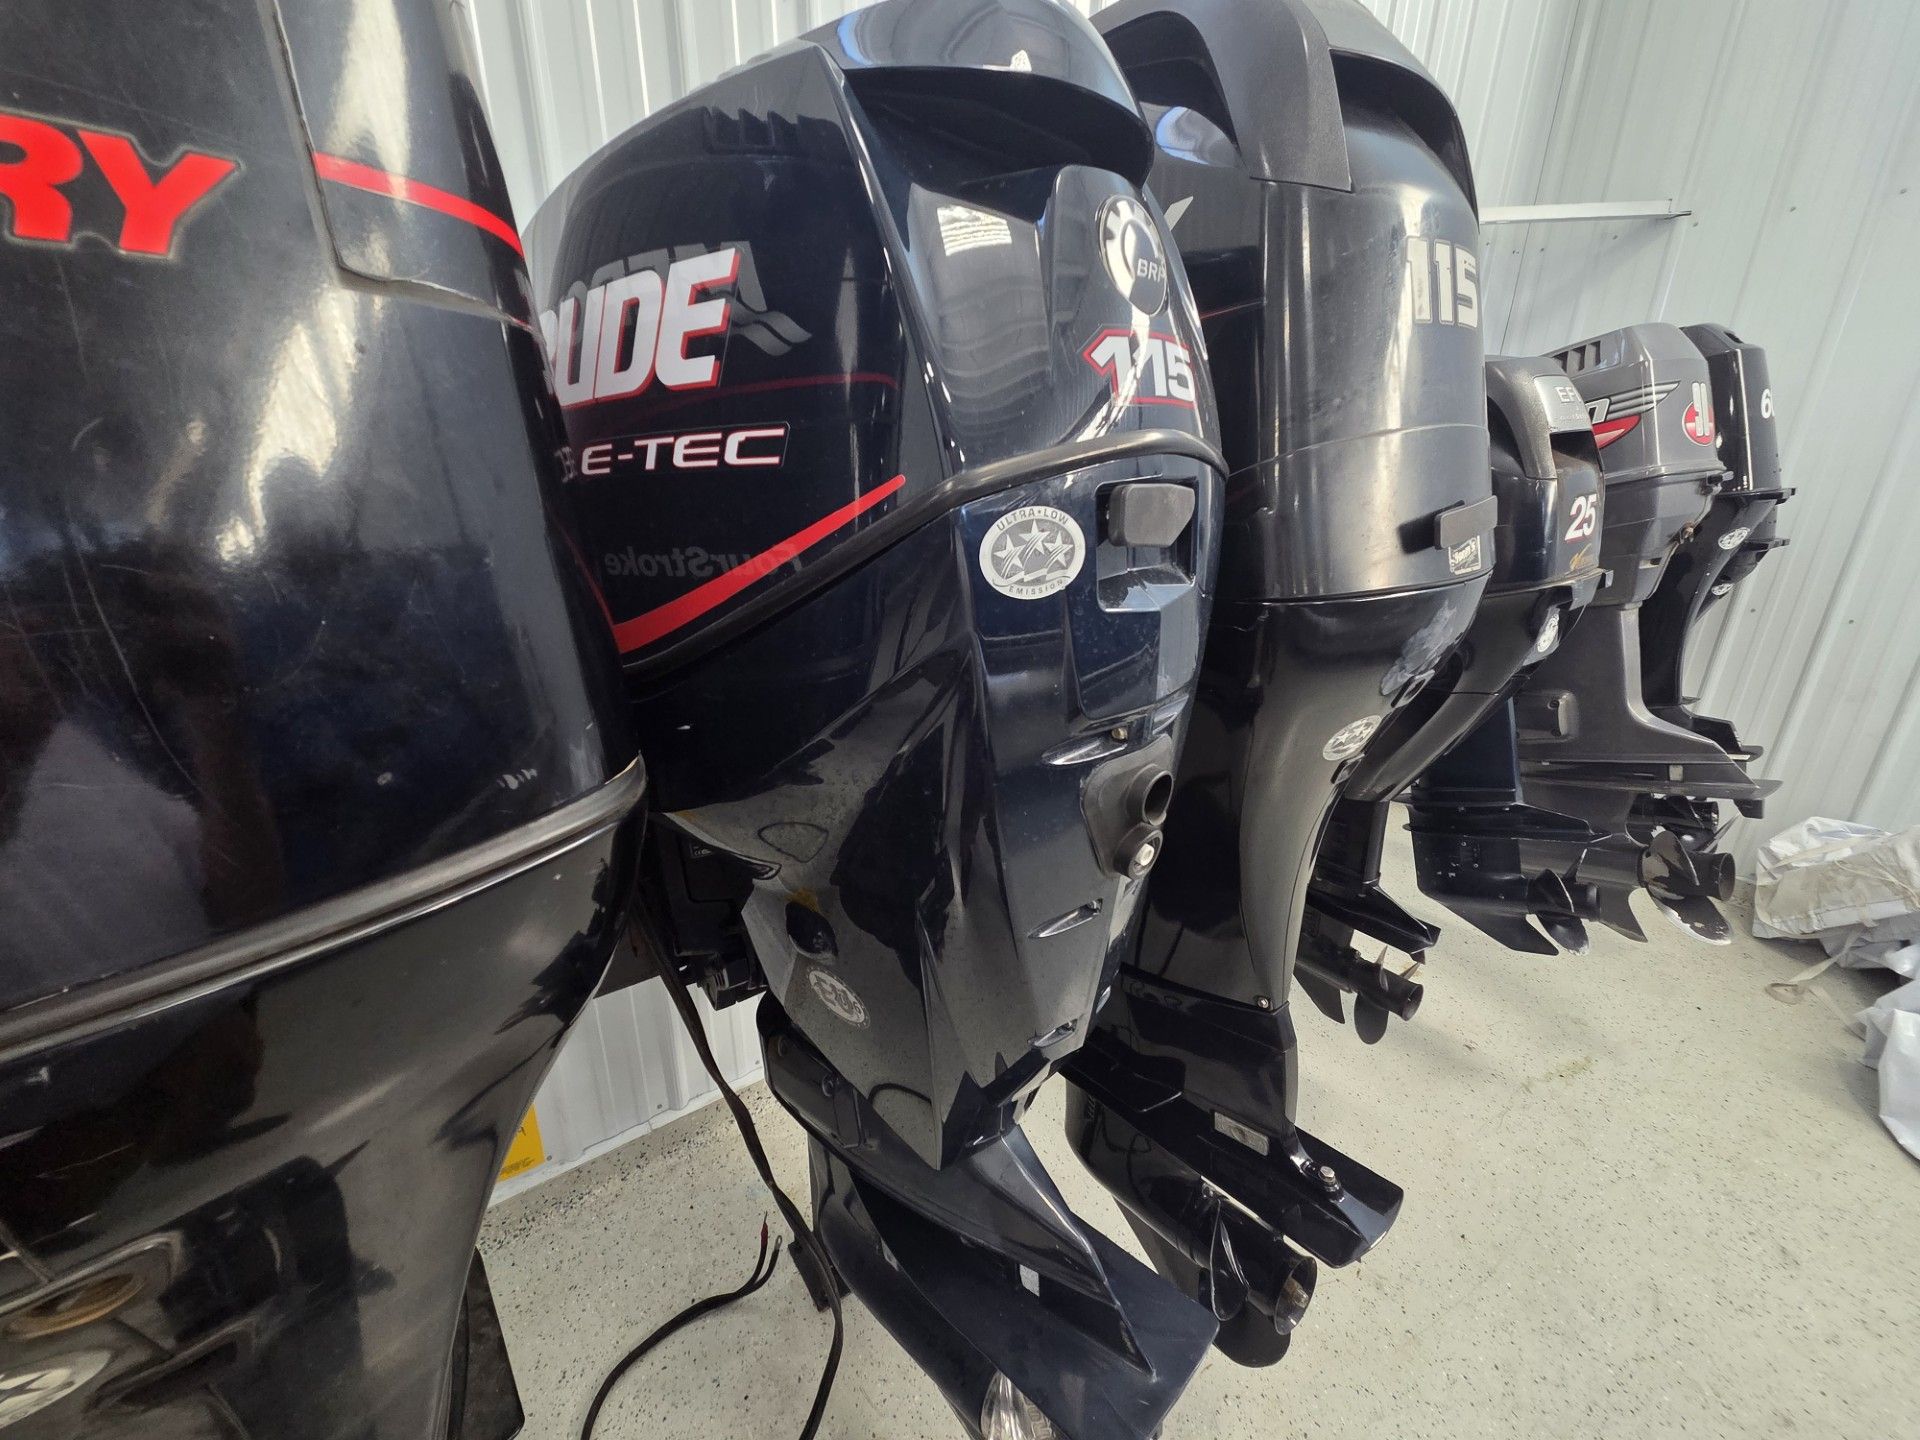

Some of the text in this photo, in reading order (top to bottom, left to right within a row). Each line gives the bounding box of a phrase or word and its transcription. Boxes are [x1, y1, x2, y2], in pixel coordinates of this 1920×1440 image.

[0, 113, 238, 255] RY
[1137, 258, 1166, 283] BRP
[1405, 236, 1479, 329] 115
[1086, 331, 1197, 405] 115
[1761, 388, 1775, 418] 6
[581, 427, 785, 476] E-TEC
[996, 508, 1068, 532] ULTRA LOW
[1565, 494, 1597, 542] 25
[1008, 579, 1064, 596] EMISSION
